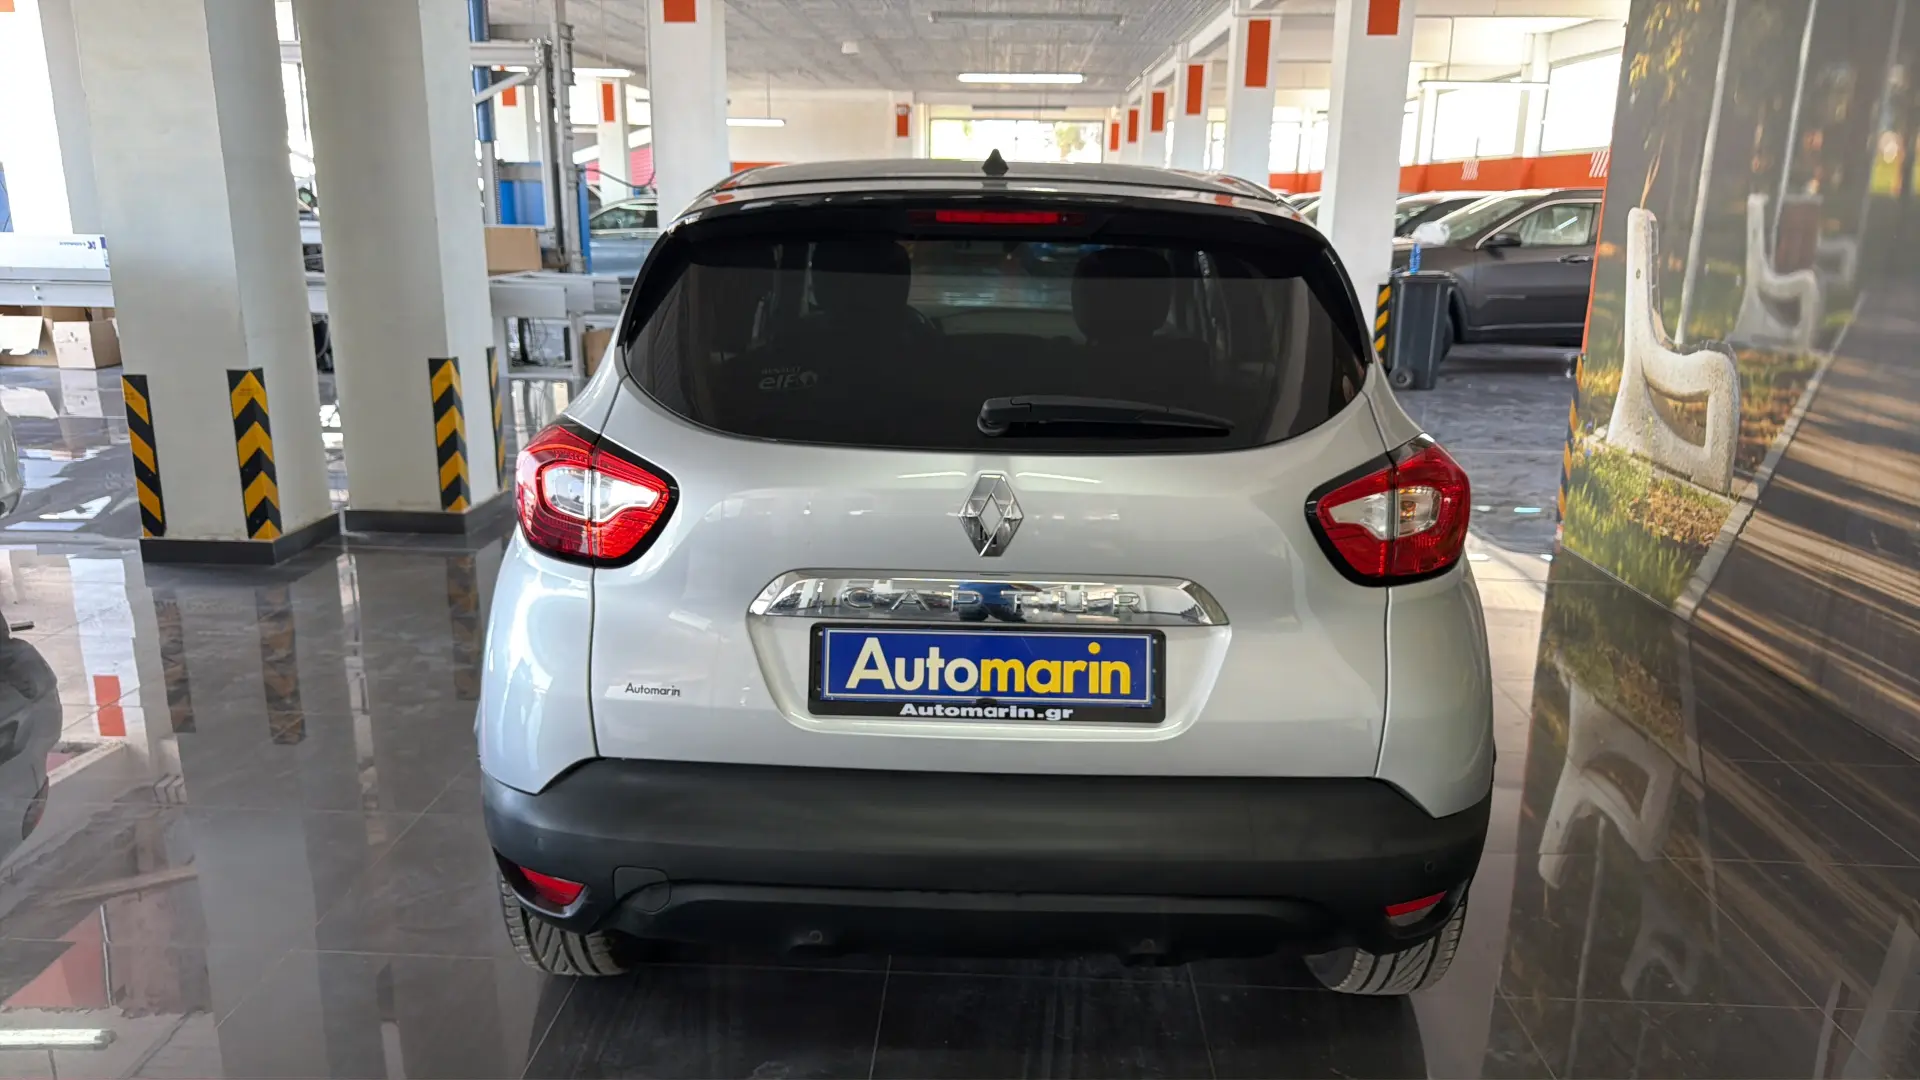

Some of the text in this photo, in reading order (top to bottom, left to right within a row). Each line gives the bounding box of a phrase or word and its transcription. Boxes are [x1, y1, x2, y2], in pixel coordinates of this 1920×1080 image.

[842, 586, 1141, 614] CAPTUR
[844, 636, 1131, 695] Automarin
[624, 682, 681, 697] Automarin
[899, 702, 1074, 721] Automarin.gr
